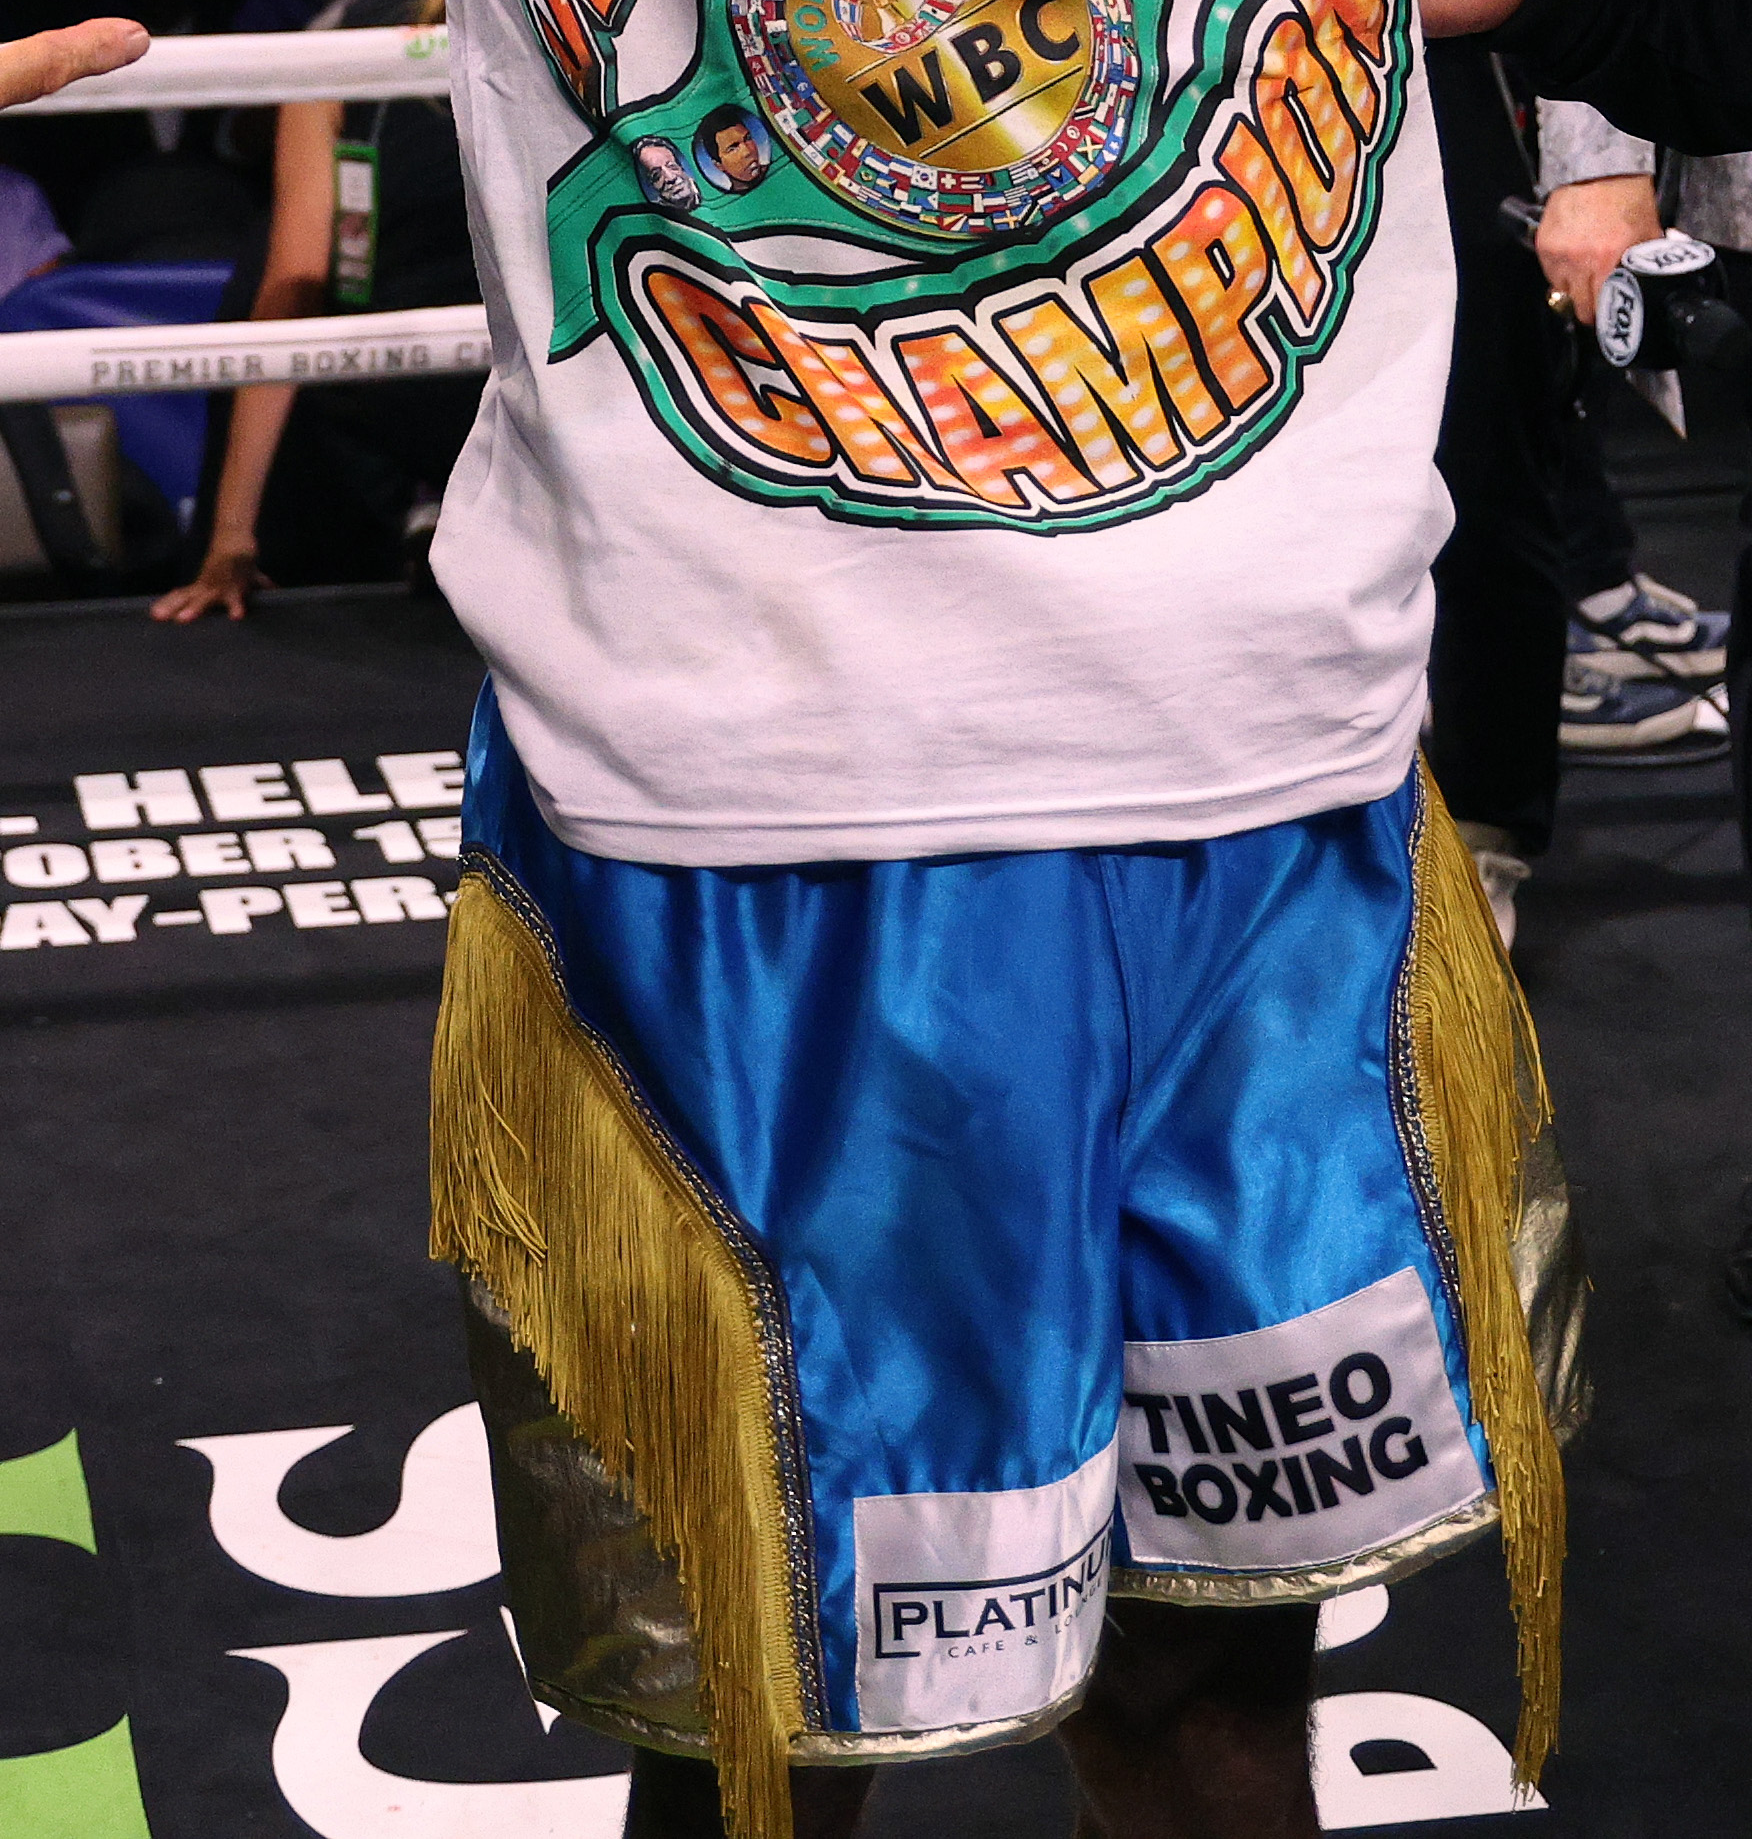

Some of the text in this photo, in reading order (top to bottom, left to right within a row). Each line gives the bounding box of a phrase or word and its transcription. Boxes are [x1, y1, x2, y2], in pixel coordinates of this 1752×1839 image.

[92, 352, 265, 386] PREMIER
[291, 343, 430, 375] BOXING
[1125, 1351, 1392, 1455] TINEO
[1135, 1416, 1429, 1525] BOXING
[948, 1640, 1006, 1659] CAFE
[1024, 1634, 1039, 1646] &
